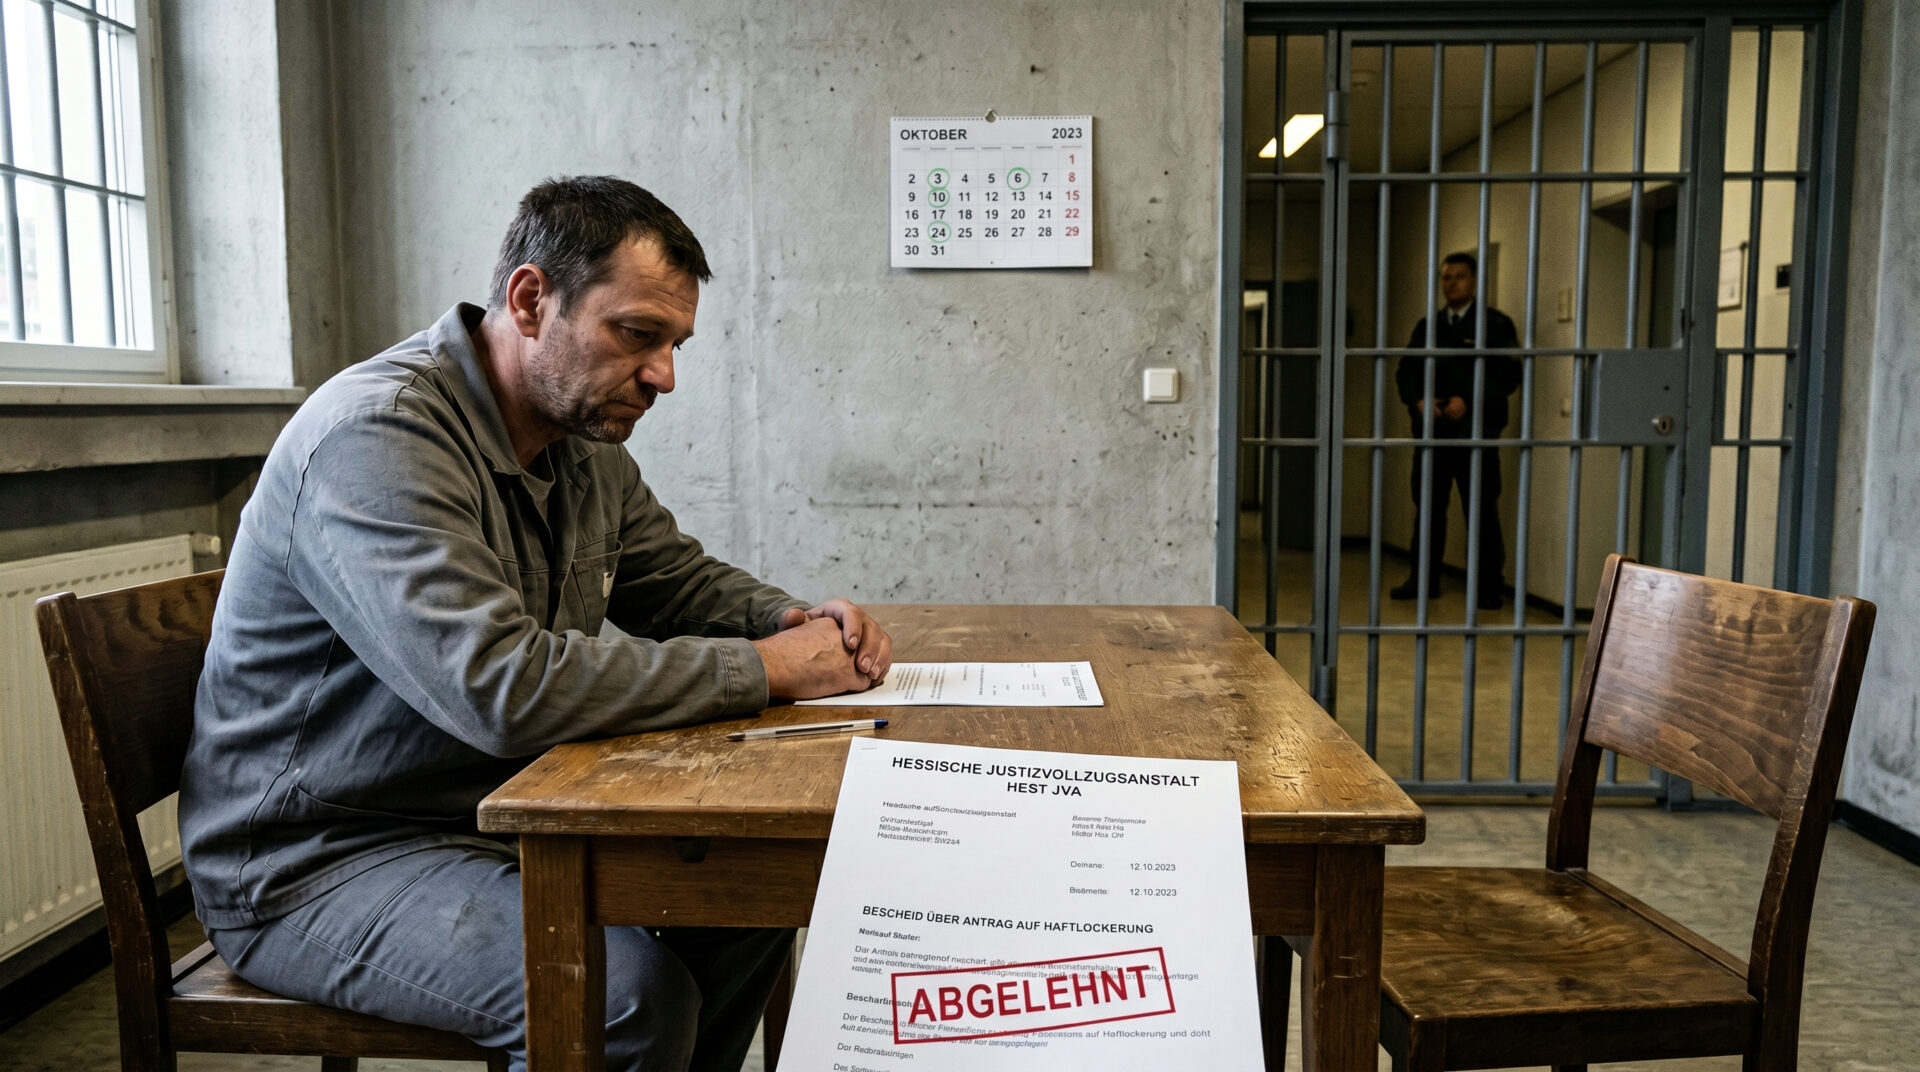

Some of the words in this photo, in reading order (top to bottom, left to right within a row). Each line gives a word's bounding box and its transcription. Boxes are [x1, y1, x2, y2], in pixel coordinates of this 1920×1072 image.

[900, 129, 967, 140] OKTOBER
[1052, 128, 1082, 139] 2023
[1070, 154, 1074, 164] 1
[909, 174, 915, 184] 2
[935, 173, 942, 184] 3
[961, 174, 968, 183] 4
[988, 173, 995, 183] 5
[1015, 173, 1021, 183] 6
[1042, 173, 1048, 182] 7
[1068, 172, 1075, 182] 8
[908, 192, 915, 202] 9
[932, 192, 945, 202] 10
[958, 192, 970, 201] 11
[985, 192, 998, 201] 12
[1011, 191, 1025, 201] 13
[1038, 191, 1052, 200] 14
[1065, 190, 1079, 200] 15
[905, 210, 919, 219] 16
[931, 210, 945, 219] 17
[958, 209, 972, 219] 18
[985, 210, 998, 219] 19
[1011, 209, 1025, 219] 20
[1039, 209, 1050, 218] 21
[1065, 208, 1079, 218] 22
[905, 228, 919, 237] 23
[932, 228, 946, 238] 24
[958, 228, 972, 238] 25
[985, 228, 998, 237] 26
[1011, 227, 1025, 237] 27
[1038, 227, 1052, 236] 28
[1065, 227, 1079, 236] 29
[905, 245, 919, 255] 30
[931, 245, 944, 255] 31
[892, 757, 982, 774] HESSISCHE
[986, 764, 1200, 787] JUSTIZVOLLZUGSANSTALT
[1007, 782, 1048, 794] HEST
[1052, 784, 1082, 796] JVA
[1130, 863, 1176, 871] 12.10.2023
[1130, 888, 1177, 896] 12.10.2023
[862, 906, 923, 921] BESCHEID
[926, 910, 960, 925] ÜBER
[963, 916, 1013, 929] ANTRAG
[1016, 920, 1040, 930] AUF
[1044, 922, 1154, 934] HAFTLOCKERUNG
[908, 965, 1150, 1024] ABGELEHNT
